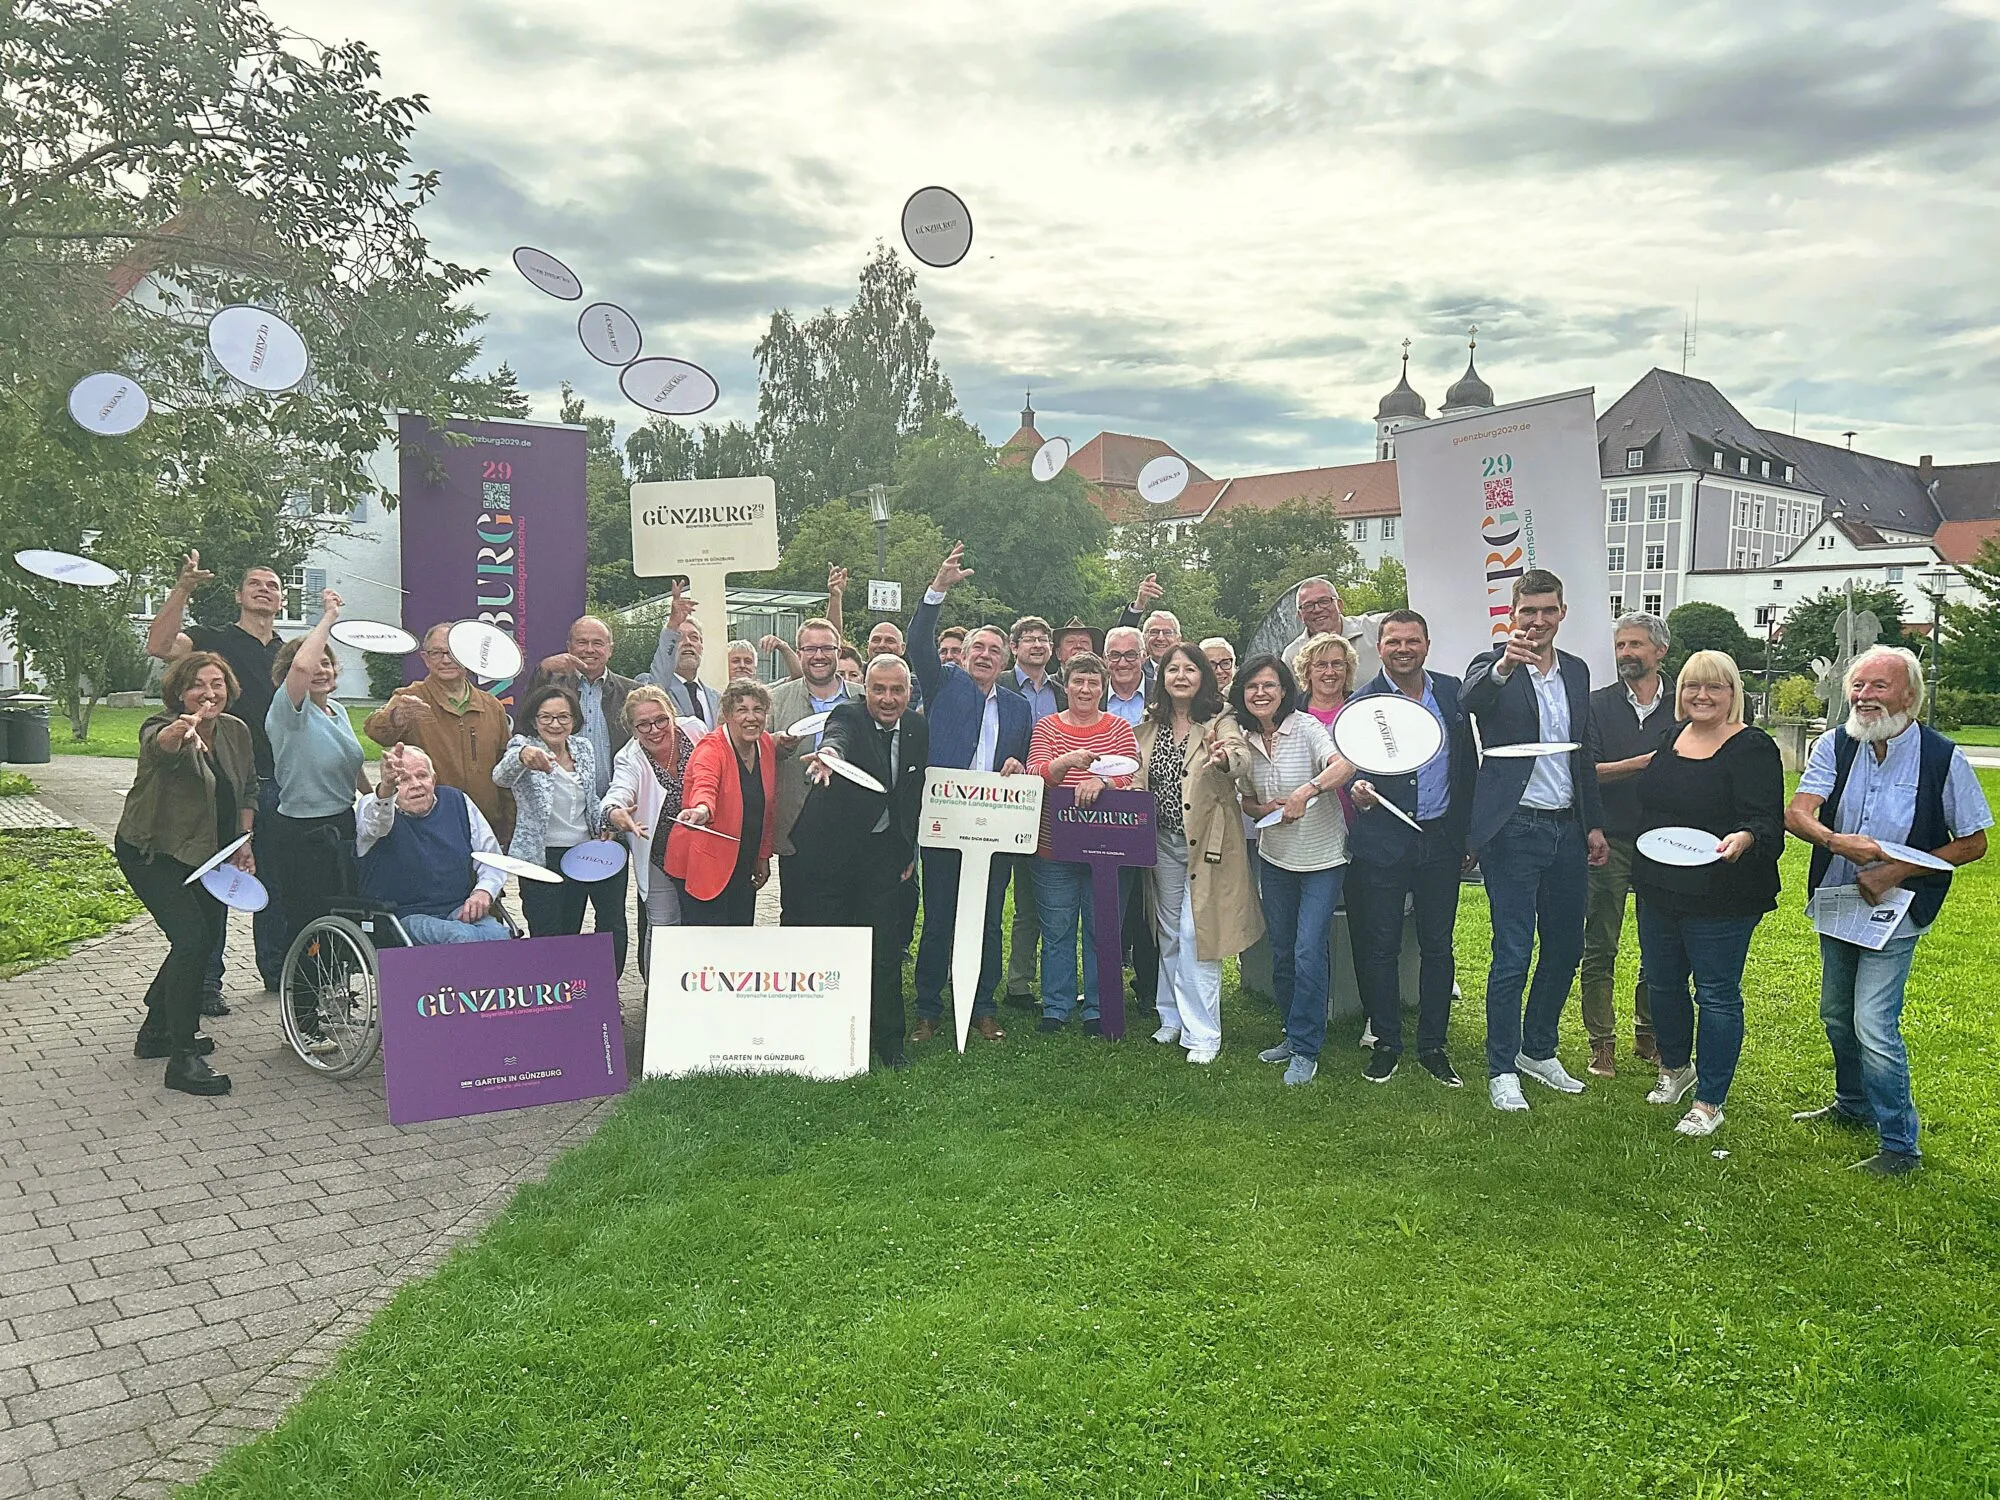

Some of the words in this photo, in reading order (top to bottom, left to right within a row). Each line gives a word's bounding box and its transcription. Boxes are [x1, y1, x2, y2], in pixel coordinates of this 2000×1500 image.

[473, 436, 531, 447] nzburg2029.de
[1452, 422, 1532, 445] guenzburg2029.de
[482, 460, 512, 480] 29
[1482, 453, 1513, 477] 29
[642, 505, 753, 526] GÜNZBURG
[1524, 508, 1537, 571] artenschau
[517, 515, 528, 616] Landesgartenschau
[930, 780, 1026, 803] GÜNZBURG
[930, 797, 967, 806] Bayerische
[968, 801, 1035, 812] Landesgartenschau
[1057, 806, 1139, 826] GÜNZBURG
[1015, 833, 1024, 844] G
[680, 966, 825, 992] GÜNZBURG
[417, 982, 572, 1018] GÜNZBURG
[570, 978, 587, 990] 29
[763, 1052, 805, 1061] GÜNZBURG
[474, 1076, 507, 1087] GARTEN
[518, 1069, 562, 1081] GÜNZBURG
